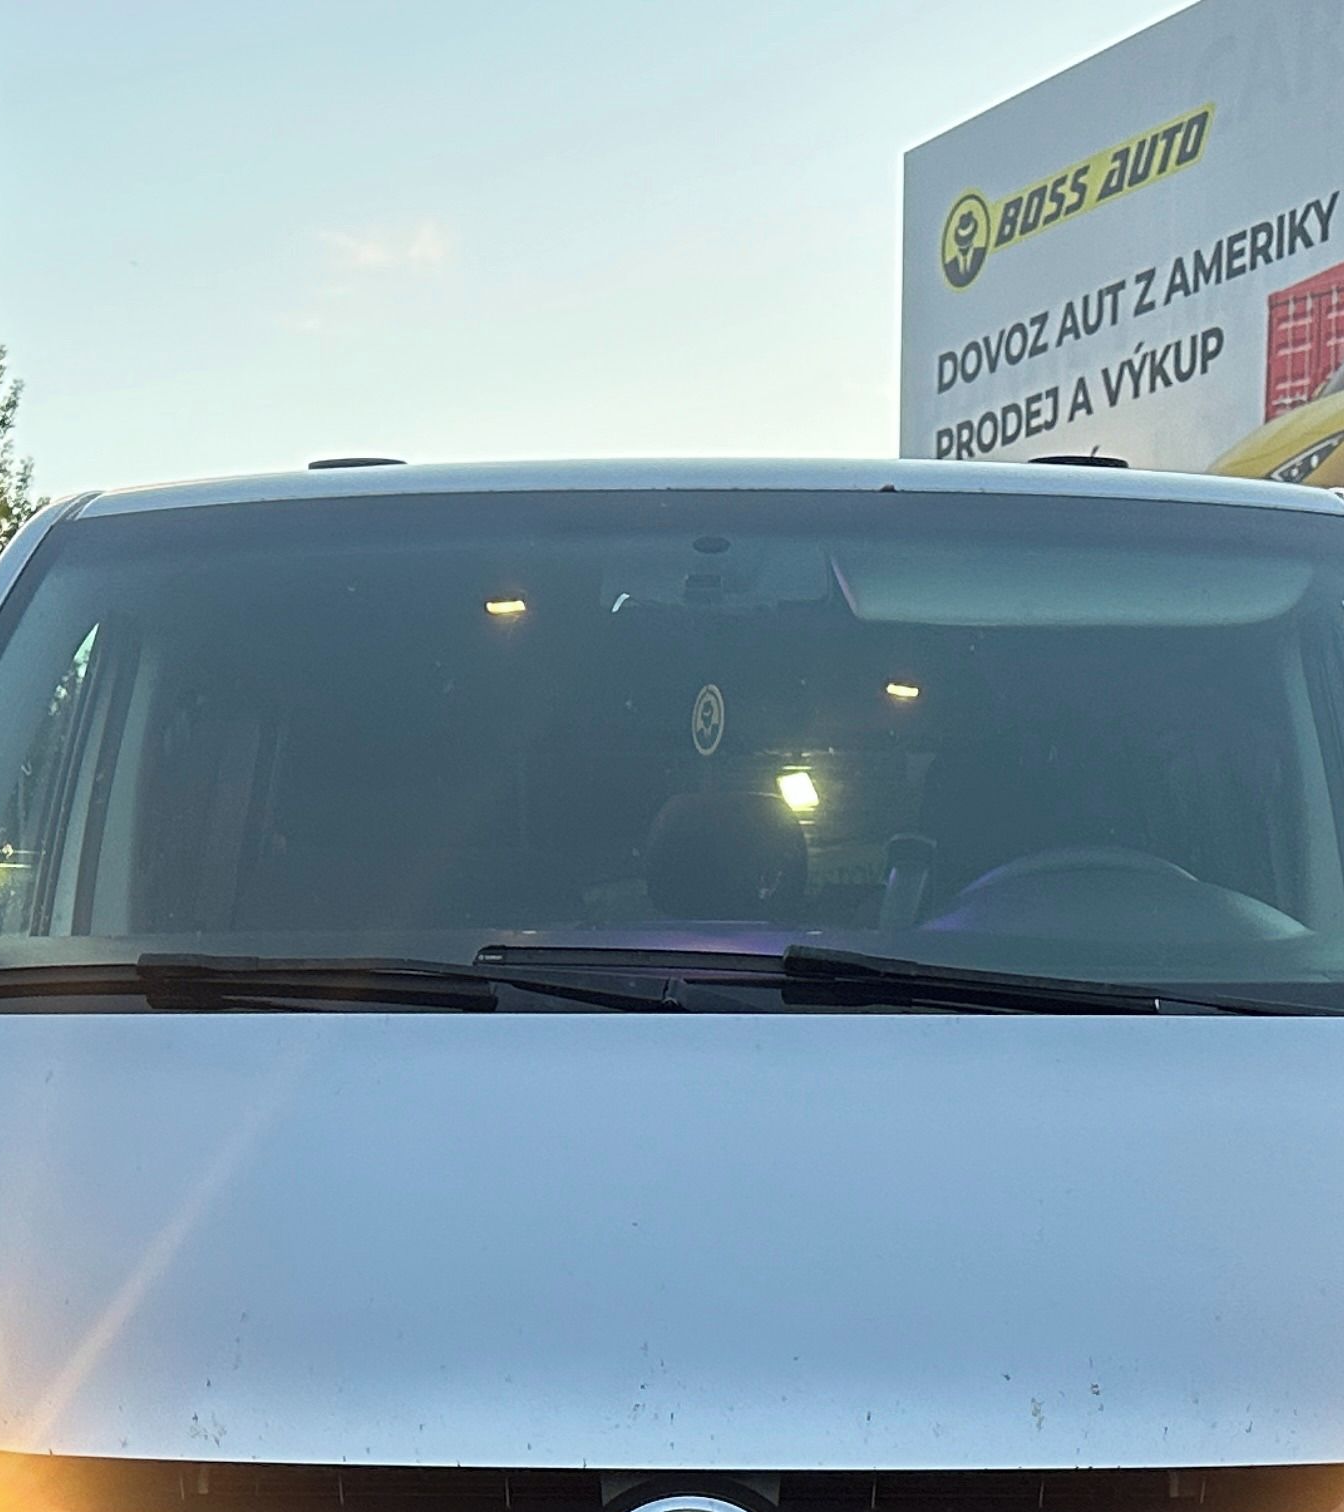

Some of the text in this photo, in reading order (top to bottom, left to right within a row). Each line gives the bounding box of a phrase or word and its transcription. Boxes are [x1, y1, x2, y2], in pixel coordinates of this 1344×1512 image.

[994, 111, 1210, 248] BOSS AUTO
[937, 190, 1341, 395] DOVOZ AUT Z AMERIKY
[936, 326, 1225, 460] PRODEJ A VÝKUP
